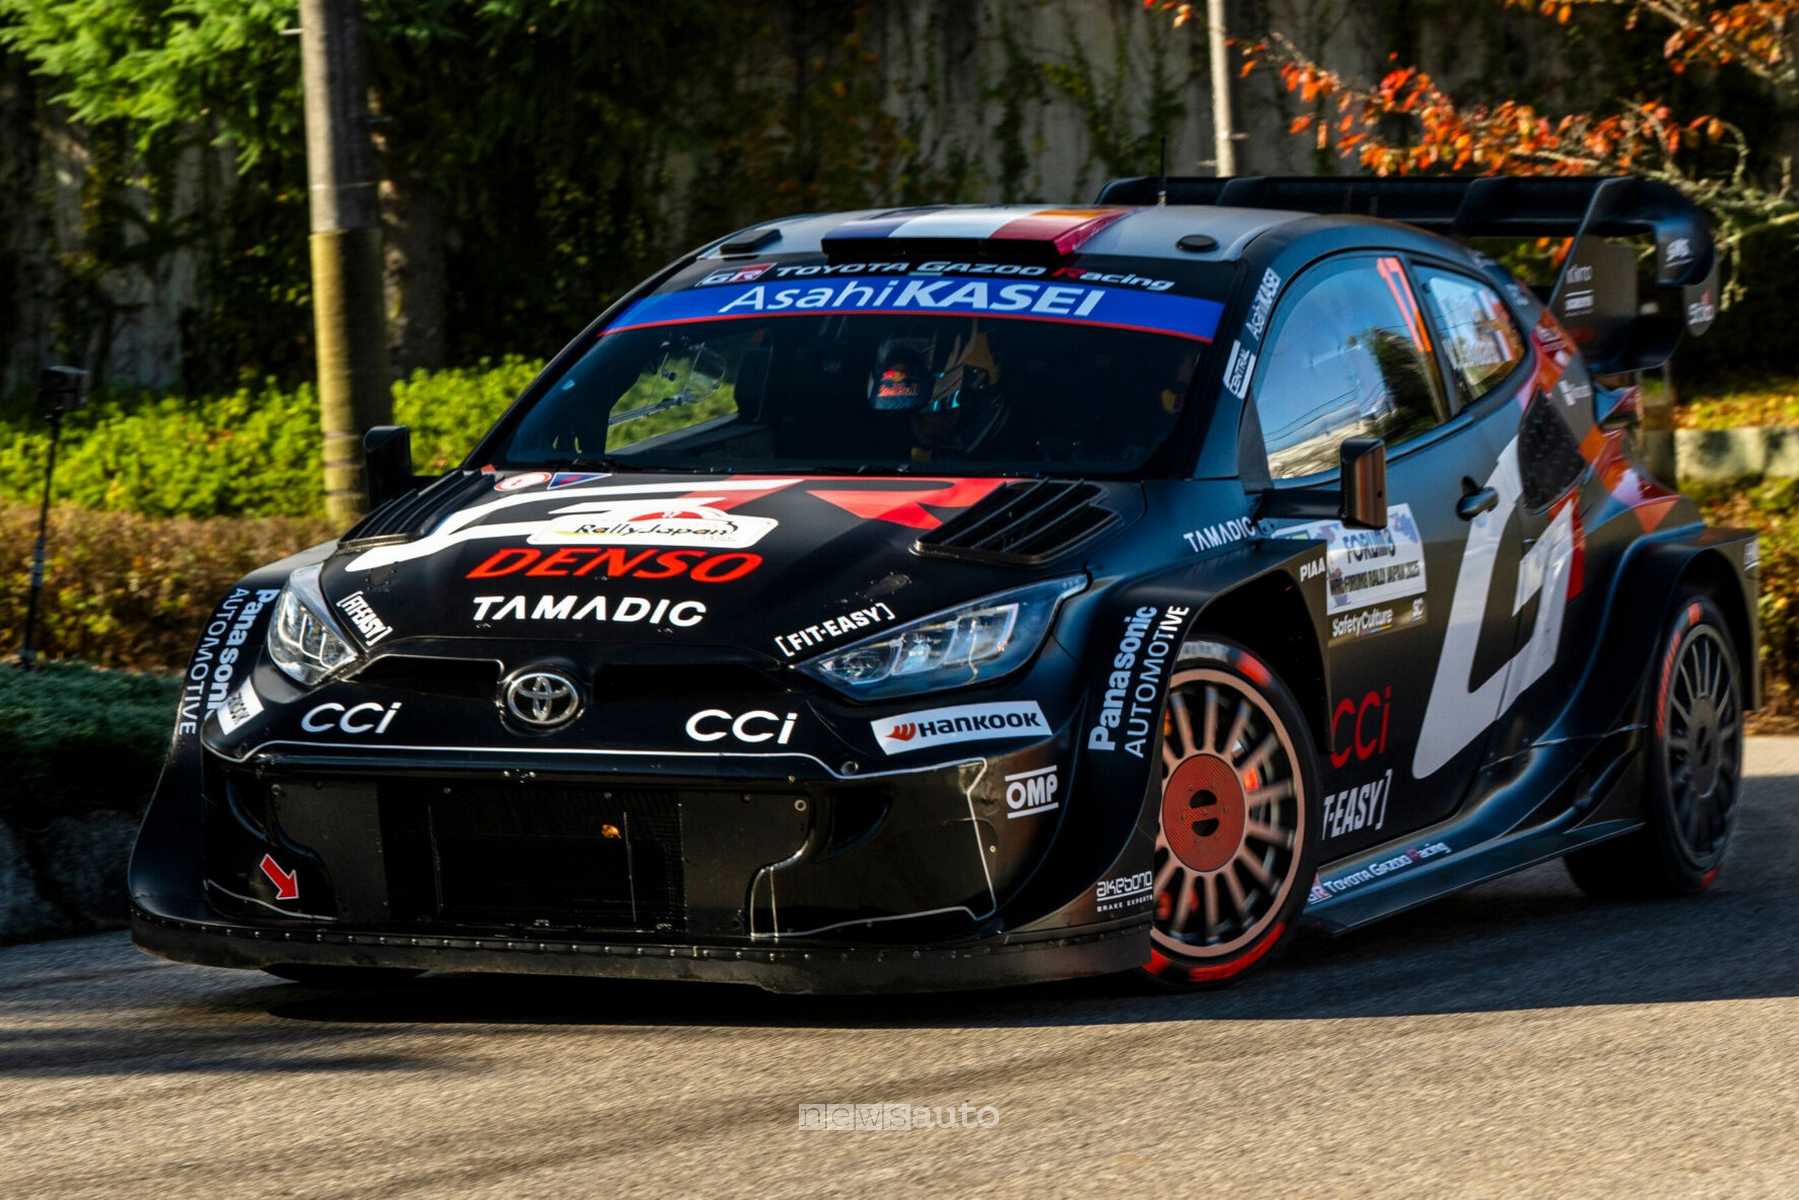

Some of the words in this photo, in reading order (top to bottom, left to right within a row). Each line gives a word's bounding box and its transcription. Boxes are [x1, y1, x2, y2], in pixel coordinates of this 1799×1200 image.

[699, 269, 764, 286] GR
[776, 263, 910, 278] TOYOTA
[916, 261, 1048, 277] GAZOO
[1052, 267, 1176, 291] Racing
[718, 279, 1106, 317] AsahiKASEI
[1183, 516, 1256, 552] TAMADIC
[465, 547, 763, 584] DENSO
[1300, 557, 1326, 583] PIAA
[473, 595, 707, 627] TAMADIC
[179, 587, 250, 736] AUTOMOTIVE
[1088, 606, 1158, 751] Panasonic
[1124, 605, 1190, 759] AUTOMOTIVE
[1006, 774, 1058, 810] OMP
[1096, 871, 1153, 898] akebono
[1323, 869, 1374, 893] TOYOTA
[1096, 902, 1123, 913] BRAKE
